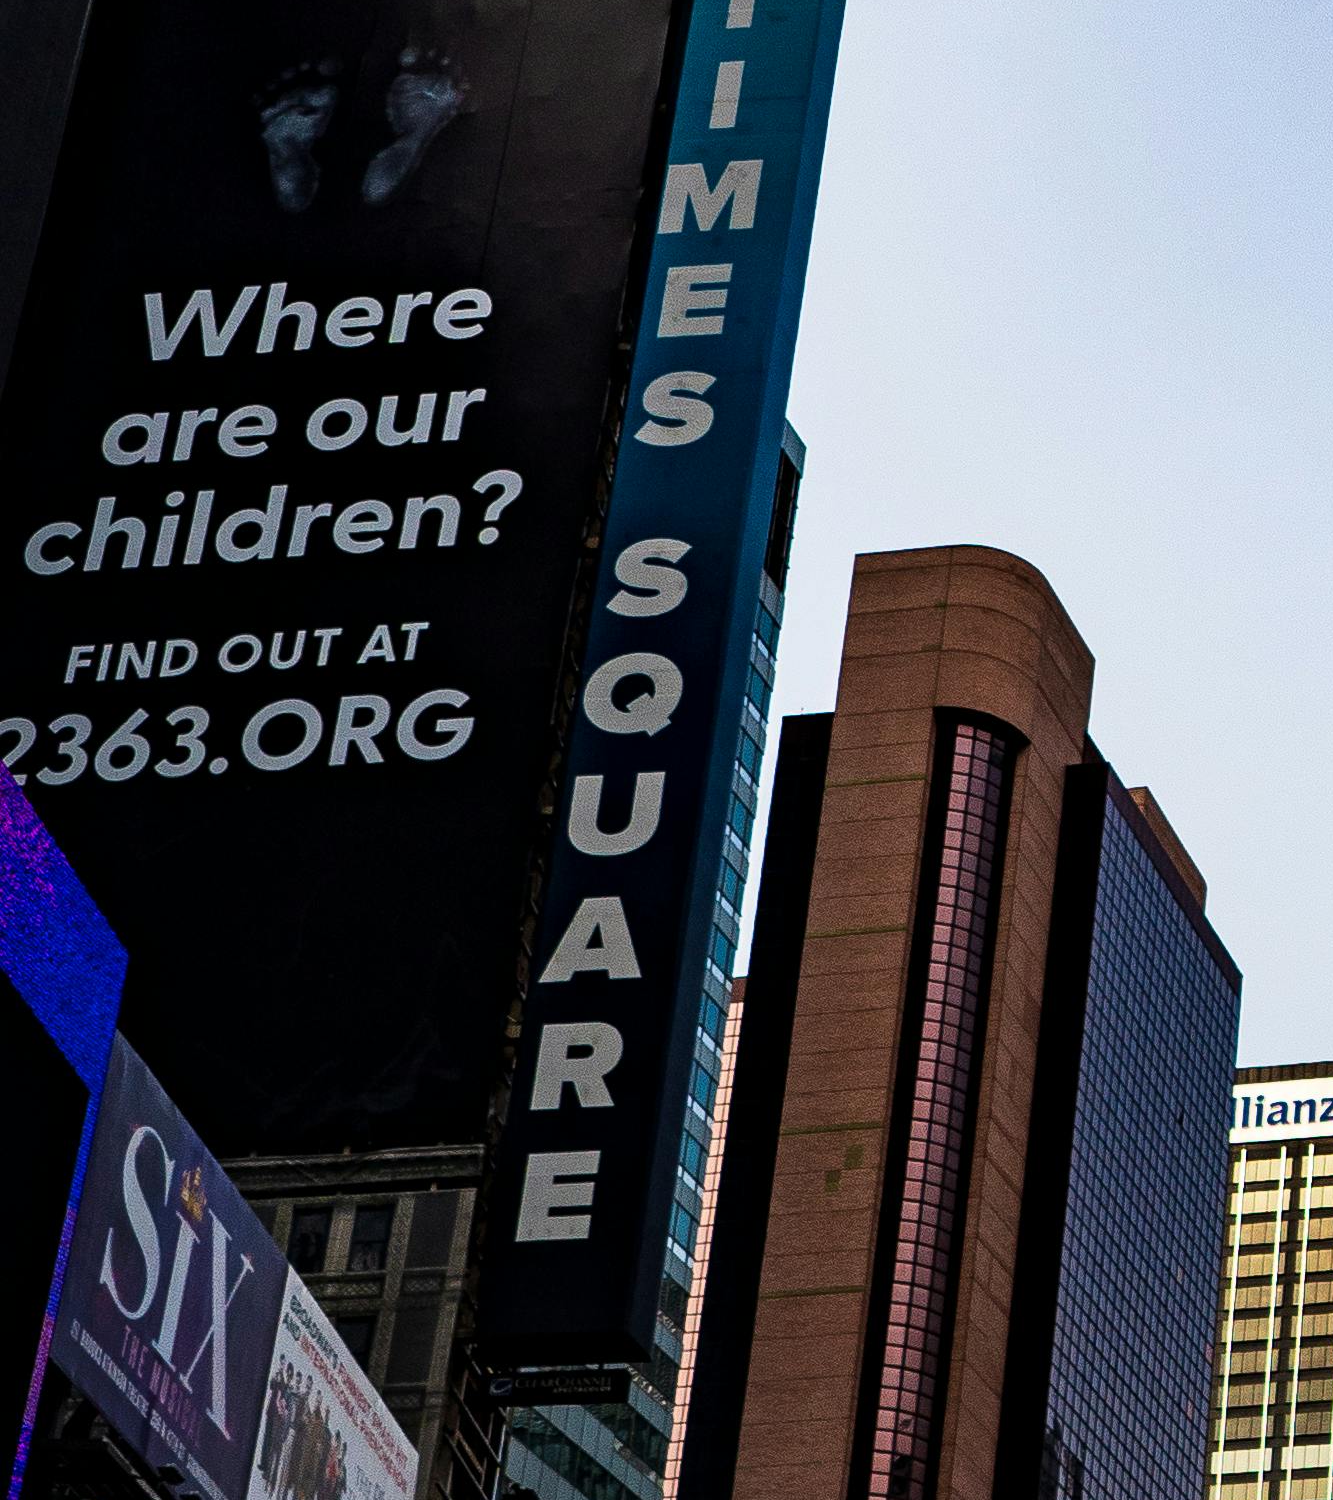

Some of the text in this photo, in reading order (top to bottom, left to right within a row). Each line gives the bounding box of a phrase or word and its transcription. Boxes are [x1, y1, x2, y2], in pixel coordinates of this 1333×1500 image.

[144, 282, 491, 361] Where
[102, 390, 485, 466] are our
[25, 470, 522, 578] children?
[66, 622, 429, 684] FIND OUT AT
[515, 537, 691, 1241] SQUARE
[100, 1126, 253, 1440] SIX
